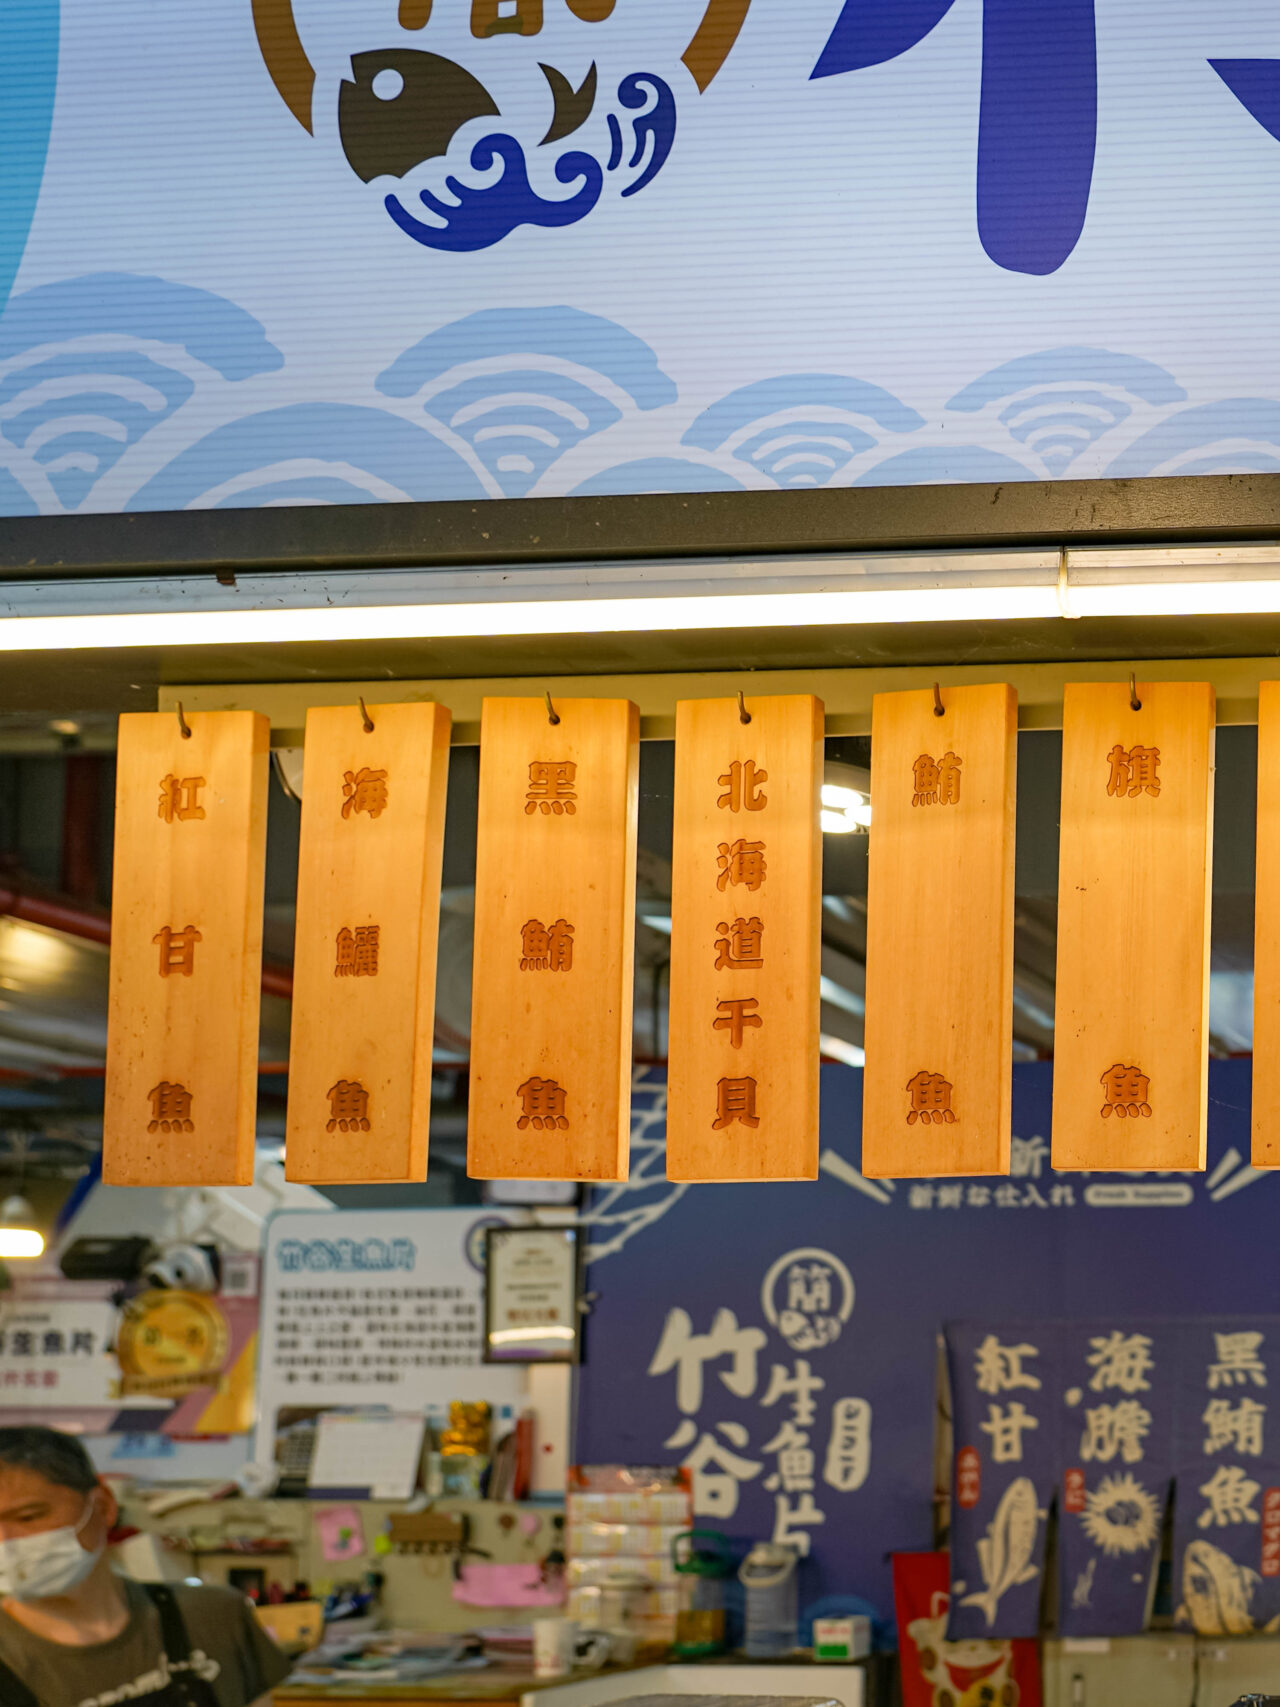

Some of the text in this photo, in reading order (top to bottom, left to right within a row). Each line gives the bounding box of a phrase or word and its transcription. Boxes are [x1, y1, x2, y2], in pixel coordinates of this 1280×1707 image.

[146, 773, 207, 1134] 紅甘魚
[326, 767, 389, 1133] 海鱺魚
[516, 760, 579, 1131] 黑鮪魚
[711, 759, 769, 1130] 北海道干貝
[906, 751, 963, 1126] 鮪魚
[1099, 744, 1161, 1120] 旗魚
[647, 1306, 768, 1519] 竹谷
[760, 1358, 825, 1557] 生魚片
[973, 1334, 1043, 1464] 紅甘
[1080, 1330, 1155, 1463] 海膽
